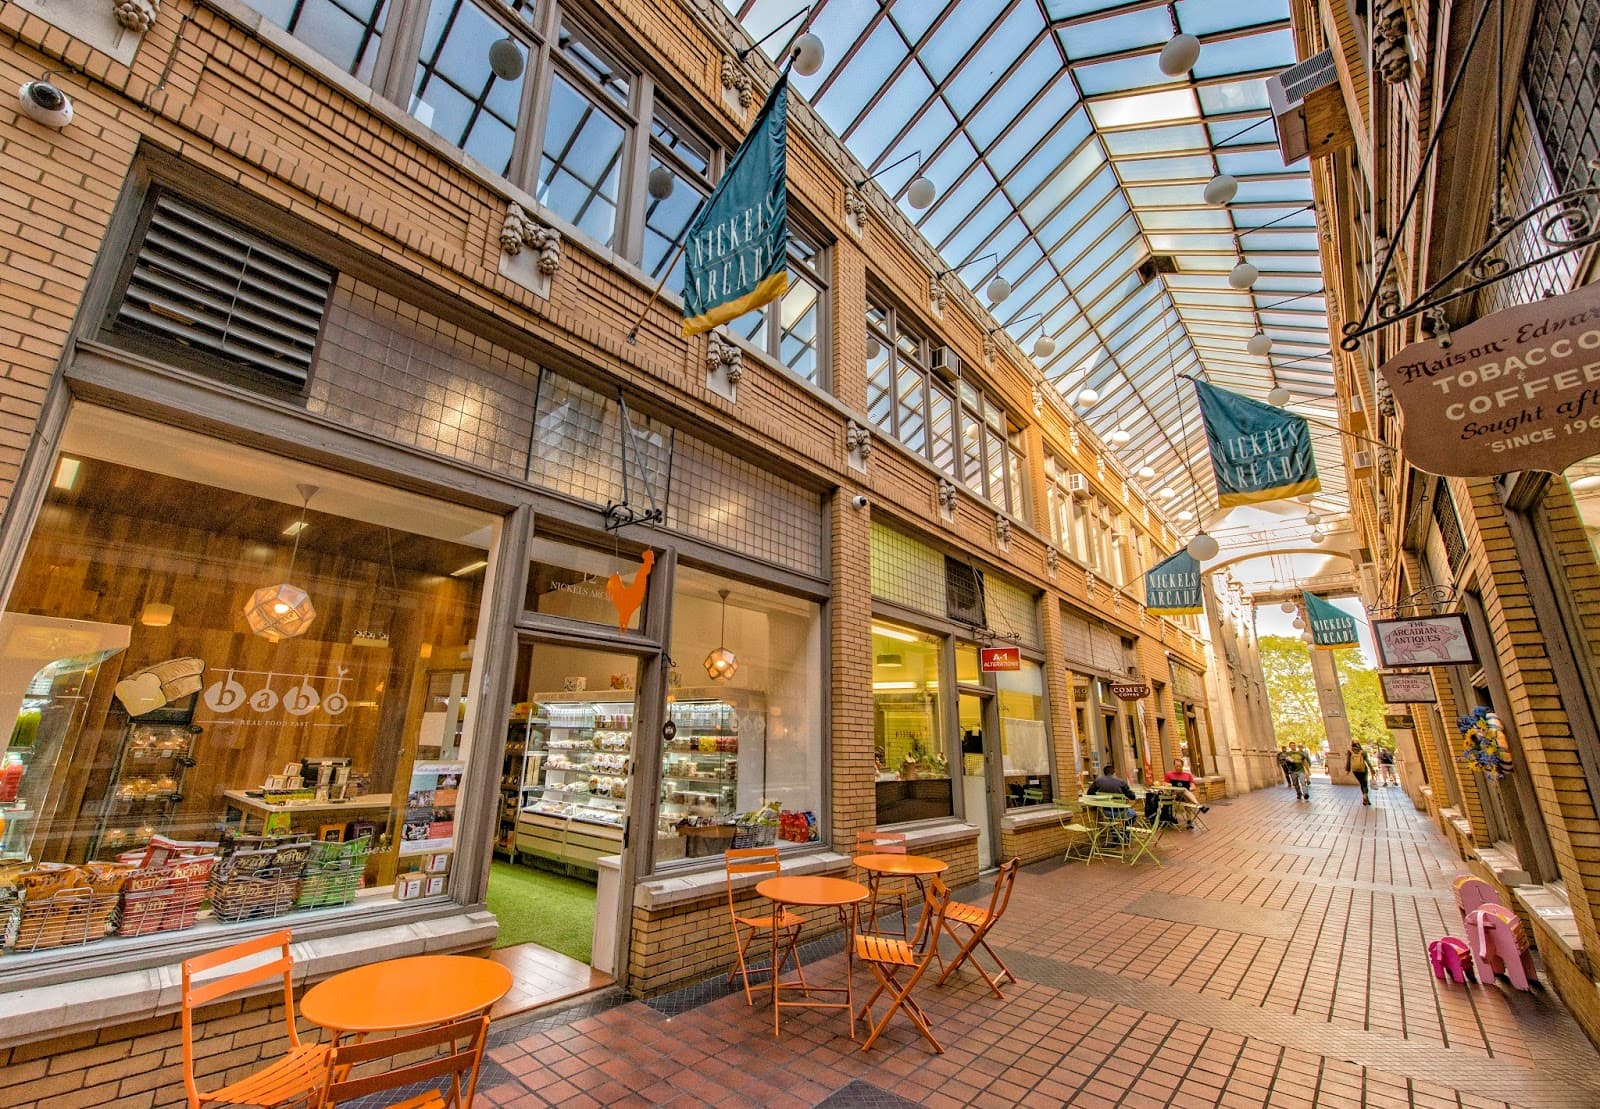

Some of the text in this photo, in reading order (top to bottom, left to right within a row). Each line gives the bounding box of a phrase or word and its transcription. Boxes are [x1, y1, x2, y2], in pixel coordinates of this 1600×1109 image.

[694, 190, 775, 269] NICKELS
[693, 233, 774, 308] ARCADE
[1433, 329, 1600, 394] TOBACCO
[1446, 361, 1600, 421] COFFEE
[1461, 406, 1544, 440] Sought
[1217, 423, 1299, 464] NICKELS
[1223, 452, 1304, 489] ARCADE
[583, 573, 597, 584] 12
[1149, 572, 1197, 588] NICKELS
[550, 581, 589, 596] NICKELS
[1150, 589, 1197, 606] ARCADE
[1313, 617, 1352, 631] NICKELS
[1393, 627, 1438, 637] ARCADIAN
[1317, 629, 1355, 644] ARCADE
[1394, 634, 1441, 645] ANTIQUES
[993, 652, 1008, 661] A-1
[203, 667, 350, 716] babo
[240, 719, 261, 727] REAL
